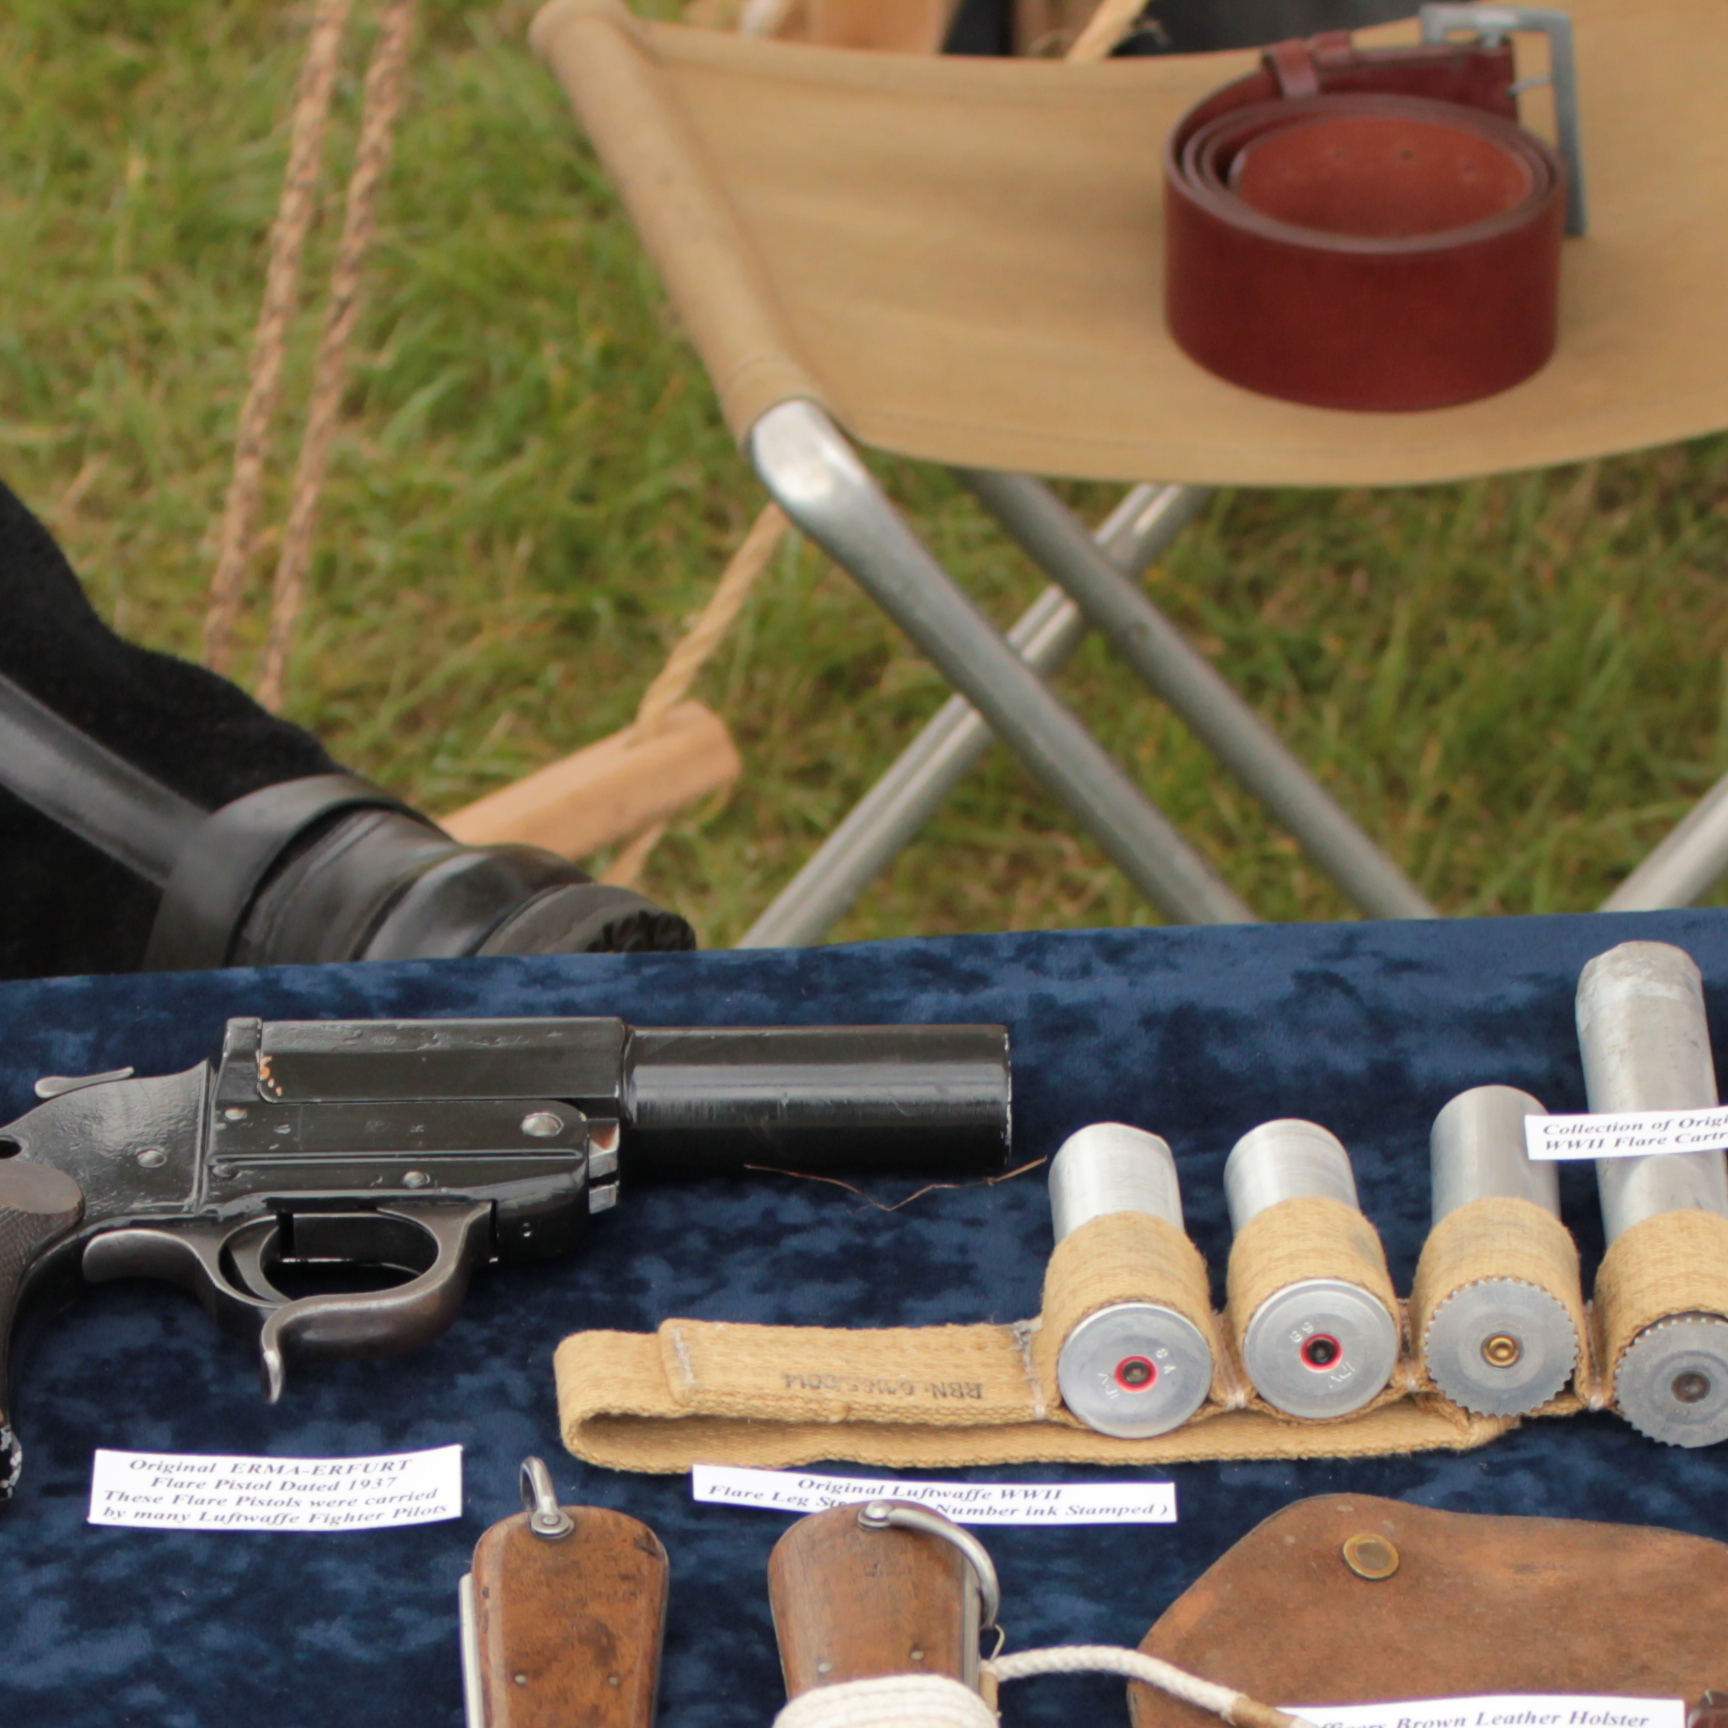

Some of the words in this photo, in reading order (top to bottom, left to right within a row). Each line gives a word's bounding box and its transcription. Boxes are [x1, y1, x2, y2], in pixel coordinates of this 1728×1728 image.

[1543, 1122, 1643, 1135] Collection
[1651, 1120, 1673, 1131] of
[1545, 1139, 1605, 1150] WWII
[1614, 1136, 1667, 1147] Flare
[129, 1459, 218, 1474] Original
[231, 1459, 412, 1476] ERMA-ERFURT
[151, 1477, 207, 1489] Flare
[214, 1478, 272, 1491] Pistol
[279, 1479, 340, 1491] Dated
[348, 1477, 397, 1490] 1937
[798, 1479, 885, 1496] Original
[892, 1486, 992, 1502] Luftwaffe
[1001, 1489, 1062, 1499] WWII
[104, 1491, 163, 1504] These
[171, 1493, 228, 1506] Flare
[235, 1495, 301, 1507] Pistols
[310, 1497, 358, 1507] were
[365, 1488, 438, 1505] carried
[708, 1485, 764, 1499] Flare
[771, 1492, 810, 1507] Leg
[1026, 1506, 1058, 1517] ink
[1065, 1504, 1154, 1518] Stamped
[103, 1507, 126, 1519] by
[134, 1511, 191, 1522] many
[199, 1511, 299, 1525] Luftwaffe
[308, 1512, 385, 1525] Fighter
[392, 1504, 447, 1518] Pilots
[1475, 1711, 1561, 1727] Leather
[1568, 1710, 1650, 1728] Holster
